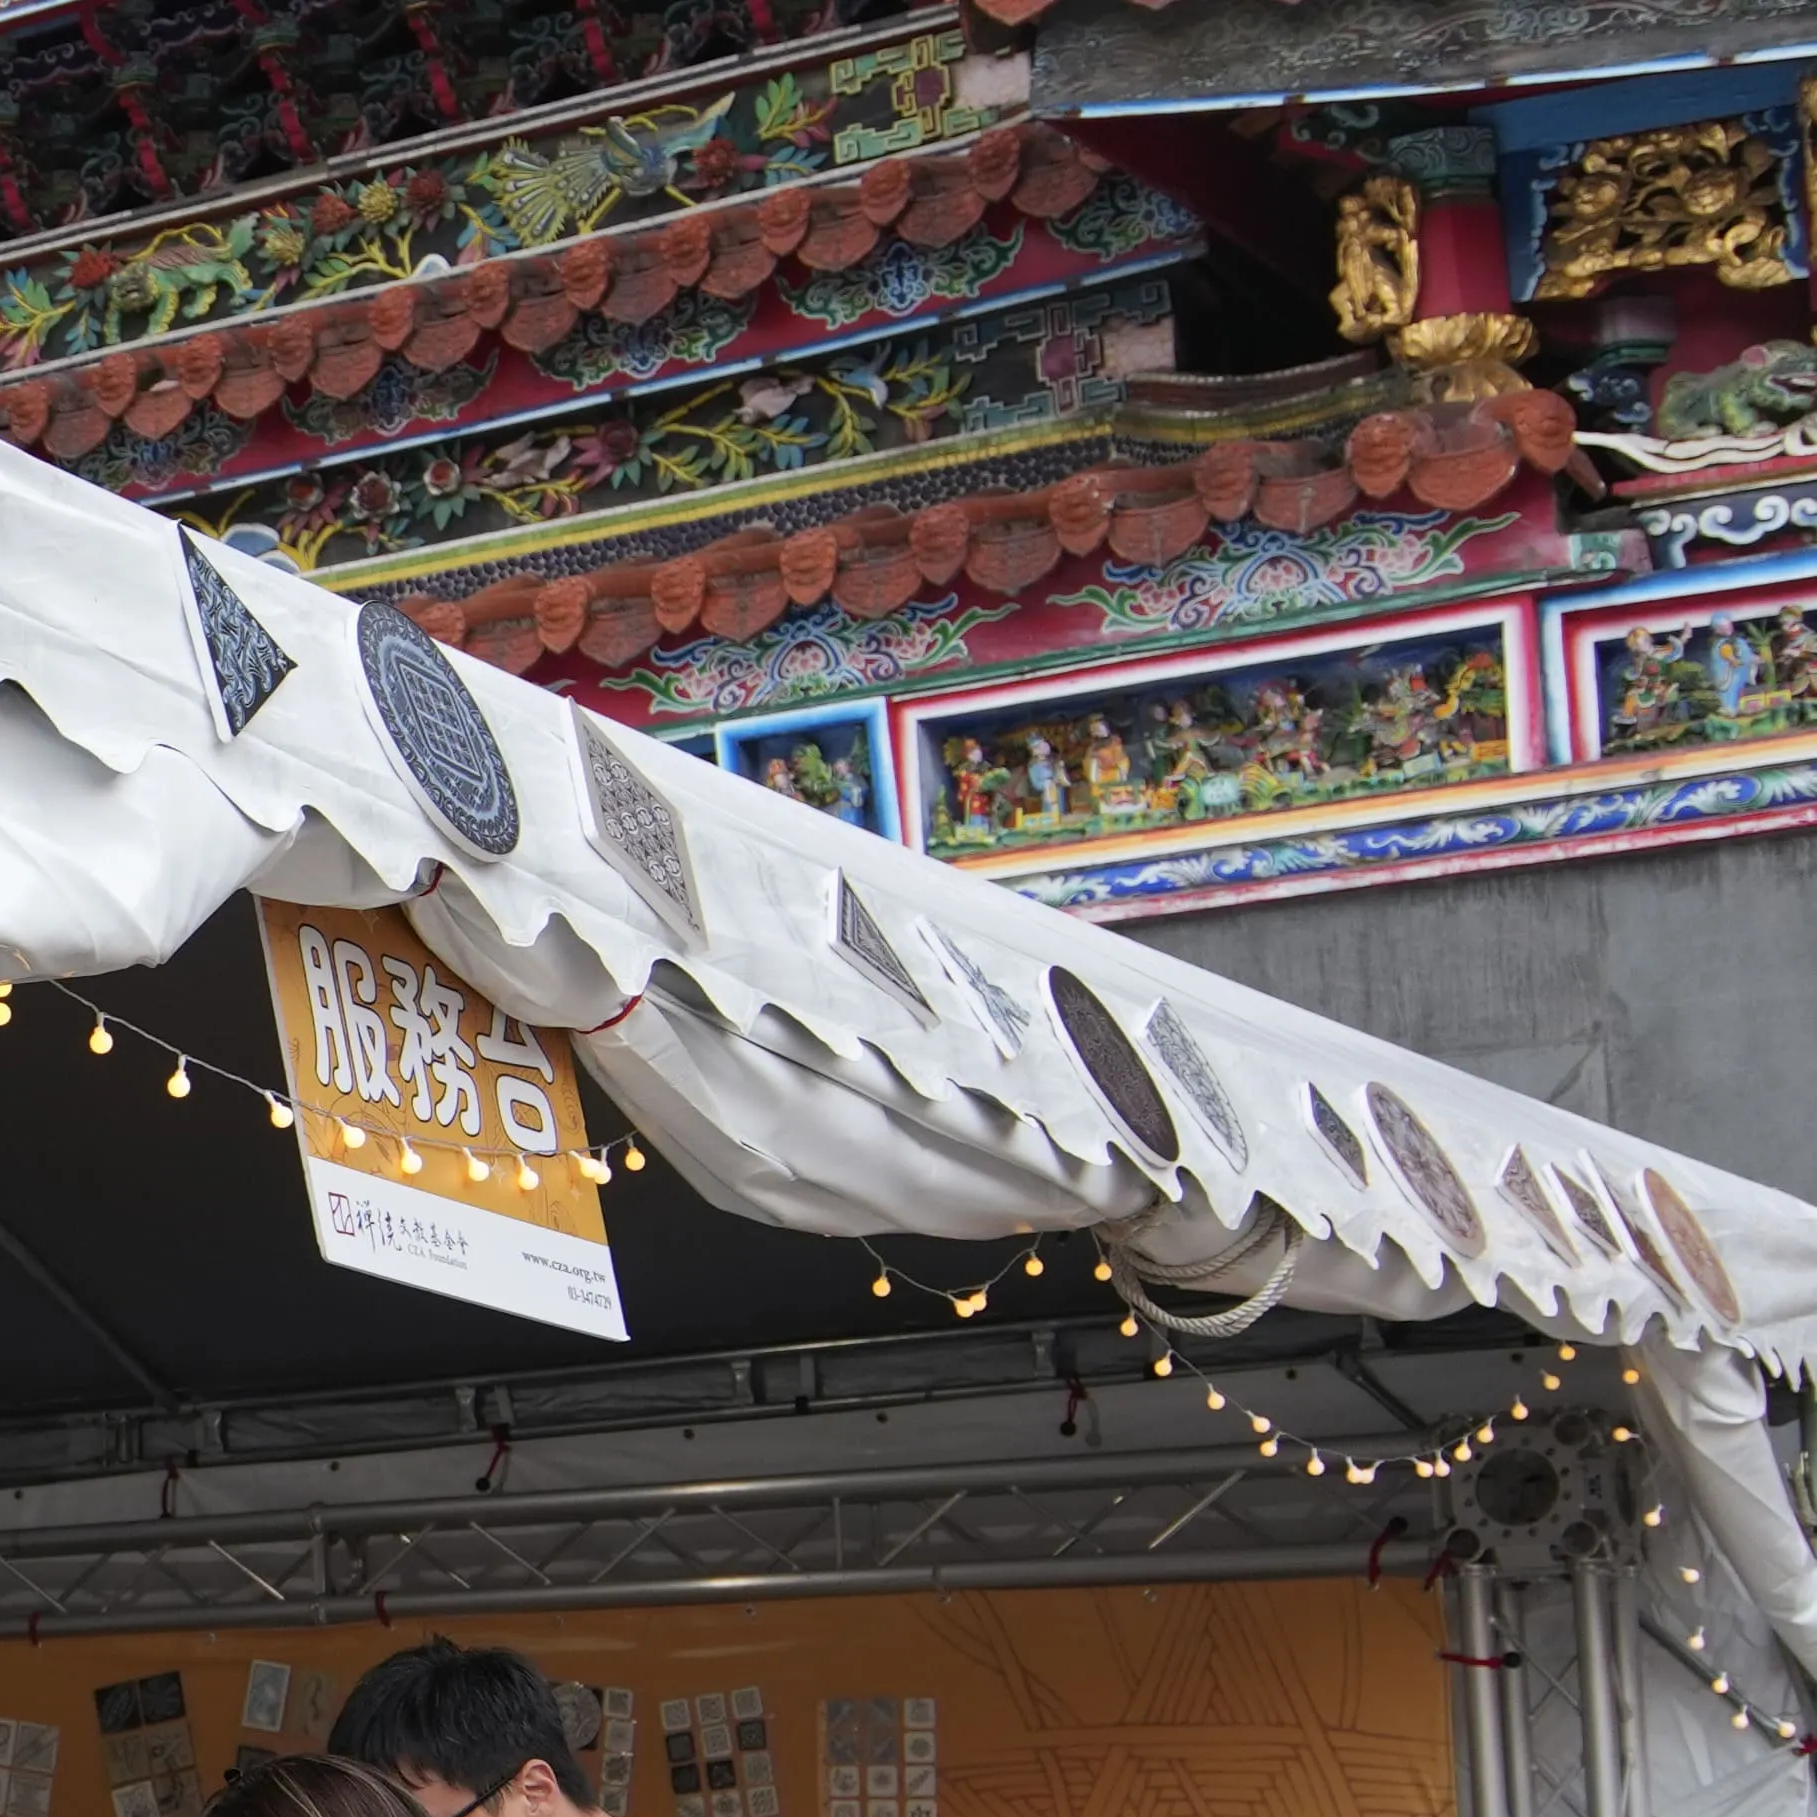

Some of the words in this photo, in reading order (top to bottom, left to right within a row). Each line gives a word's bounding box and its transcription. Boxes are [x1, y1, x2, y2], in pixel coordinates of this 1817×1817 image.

[298, 924, 558, 1156] 服務台
[521, 1251, 606, 1284] www.cza.org.tw
